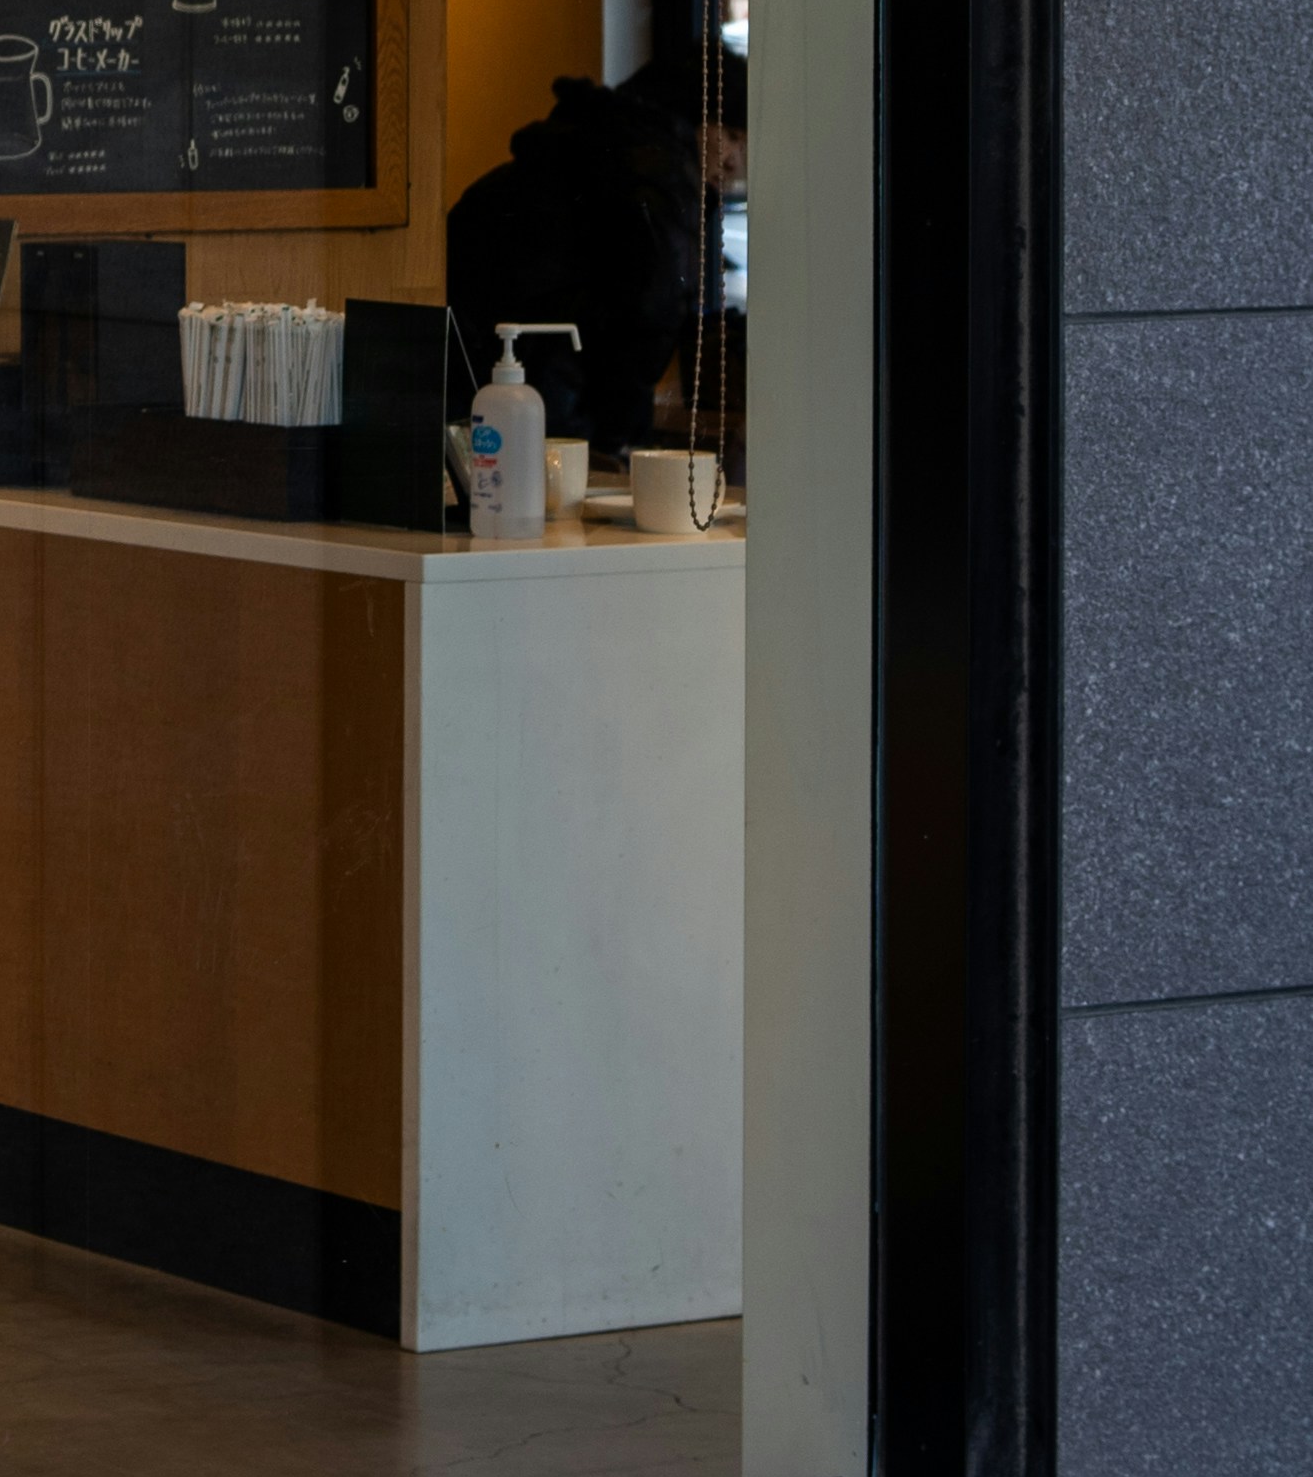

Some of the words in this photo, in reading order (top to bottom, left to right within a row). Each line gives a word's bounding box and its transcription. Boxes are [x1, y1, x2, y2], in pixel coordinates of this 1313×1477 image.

[49, 15, 143, 45] グラスドリップ
[56, 48, 140, 73] コーヒーメーカー
